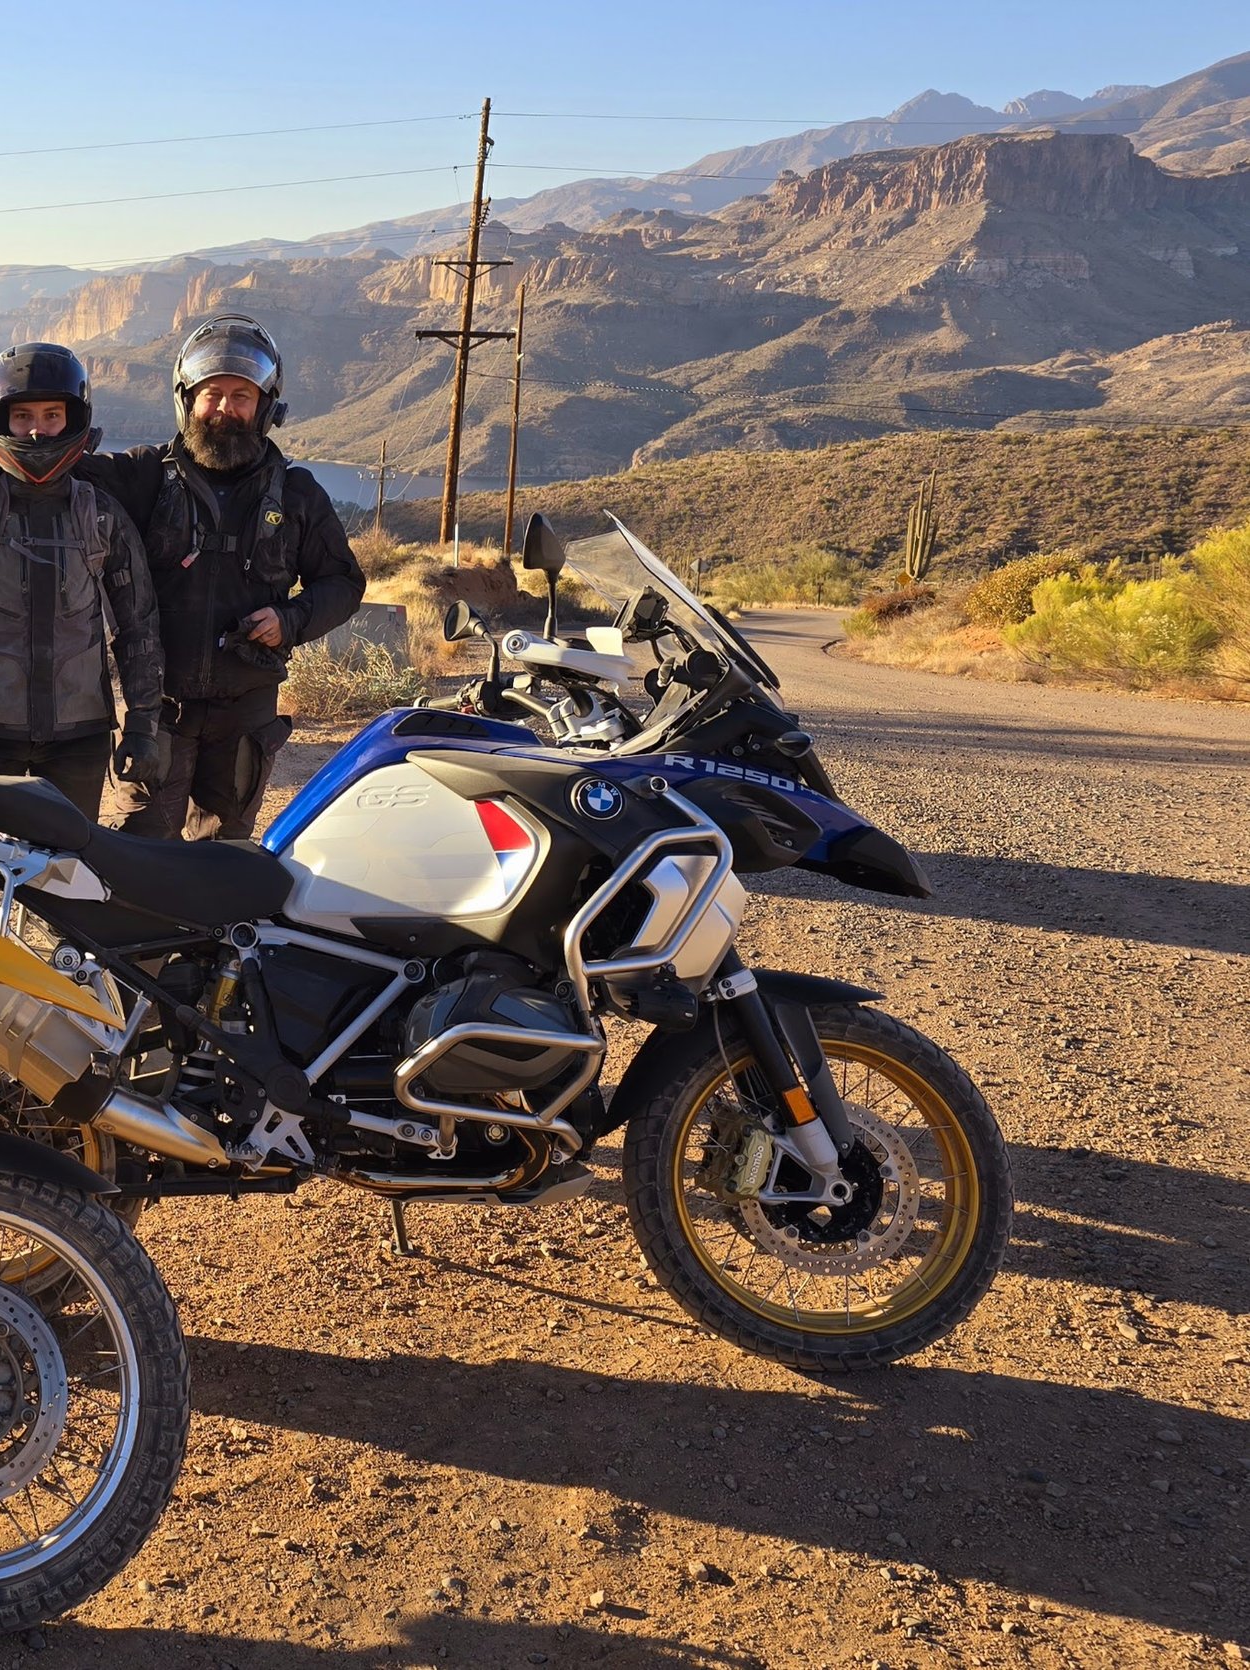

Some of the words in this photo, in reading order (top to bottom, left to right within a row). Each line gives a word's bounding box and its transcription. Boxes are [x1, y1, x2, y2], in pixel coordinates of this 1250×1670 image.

[585, 781, 619, 796] BMW
[664, 754, 696, 770] R
[699, 758, 795, 792] 1250
[356, 784, 432, 808] GS
[746, 1145, 765, 1184] brembo
